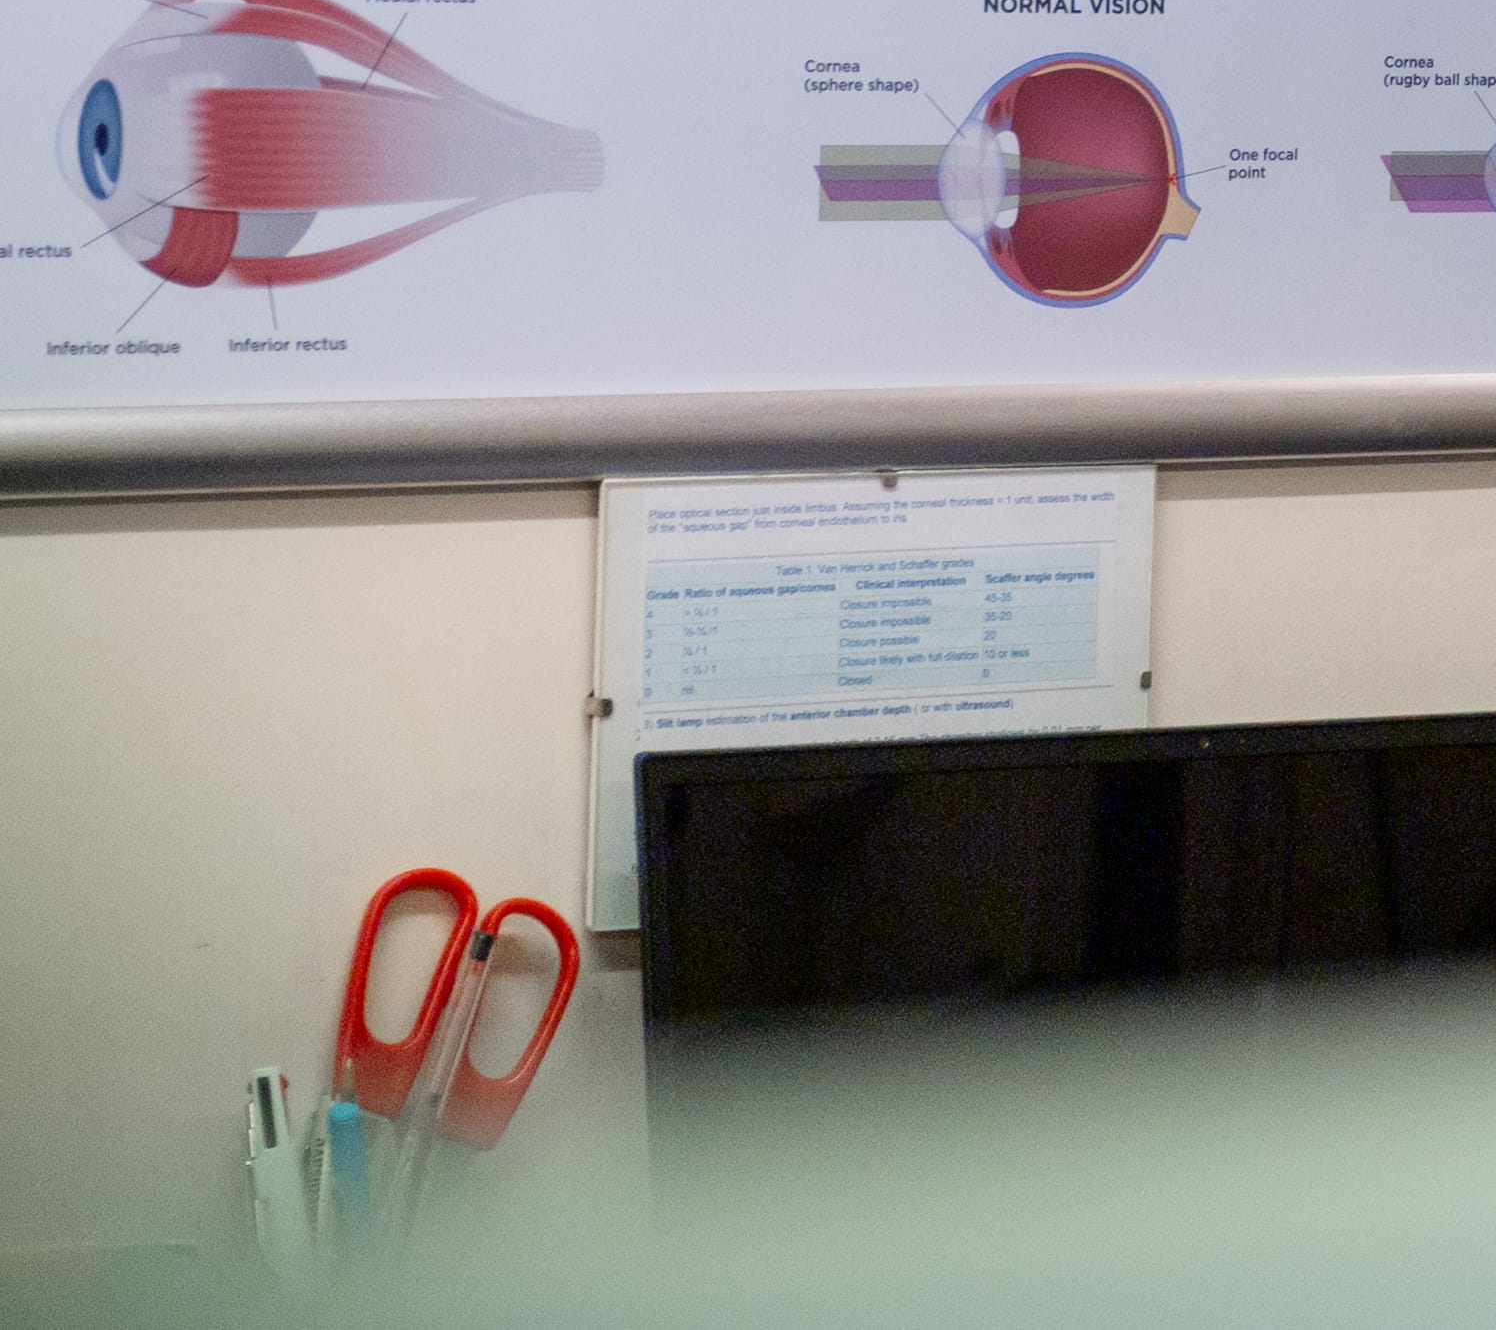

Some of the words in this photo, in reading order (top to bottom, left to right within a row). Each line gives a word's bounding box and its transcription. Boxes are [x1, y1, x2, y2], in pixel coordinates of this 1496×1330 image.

[805, 59, 860, 73] Cornea
[1384, 56, 1434, 68] Cornea
[804, 77, 863, 94] (sphere
[868, 77, 920, 94] shape)
[1383, 73, 1431, 89] (rugby
[1435, 73, 1460, 86] ball
[1229, 149, 1258, 161] One
[1263, 148, 1298, 161] focal
[1229, 166, 1266, 182] point
[19, 244, 72, 259] rectus
[47, 340, 111, 355] Inferior
[115, 339, 180, 356] oblique
[229, 337, 291, 352] Inferior
[296, 336, 347, 351] rectus
